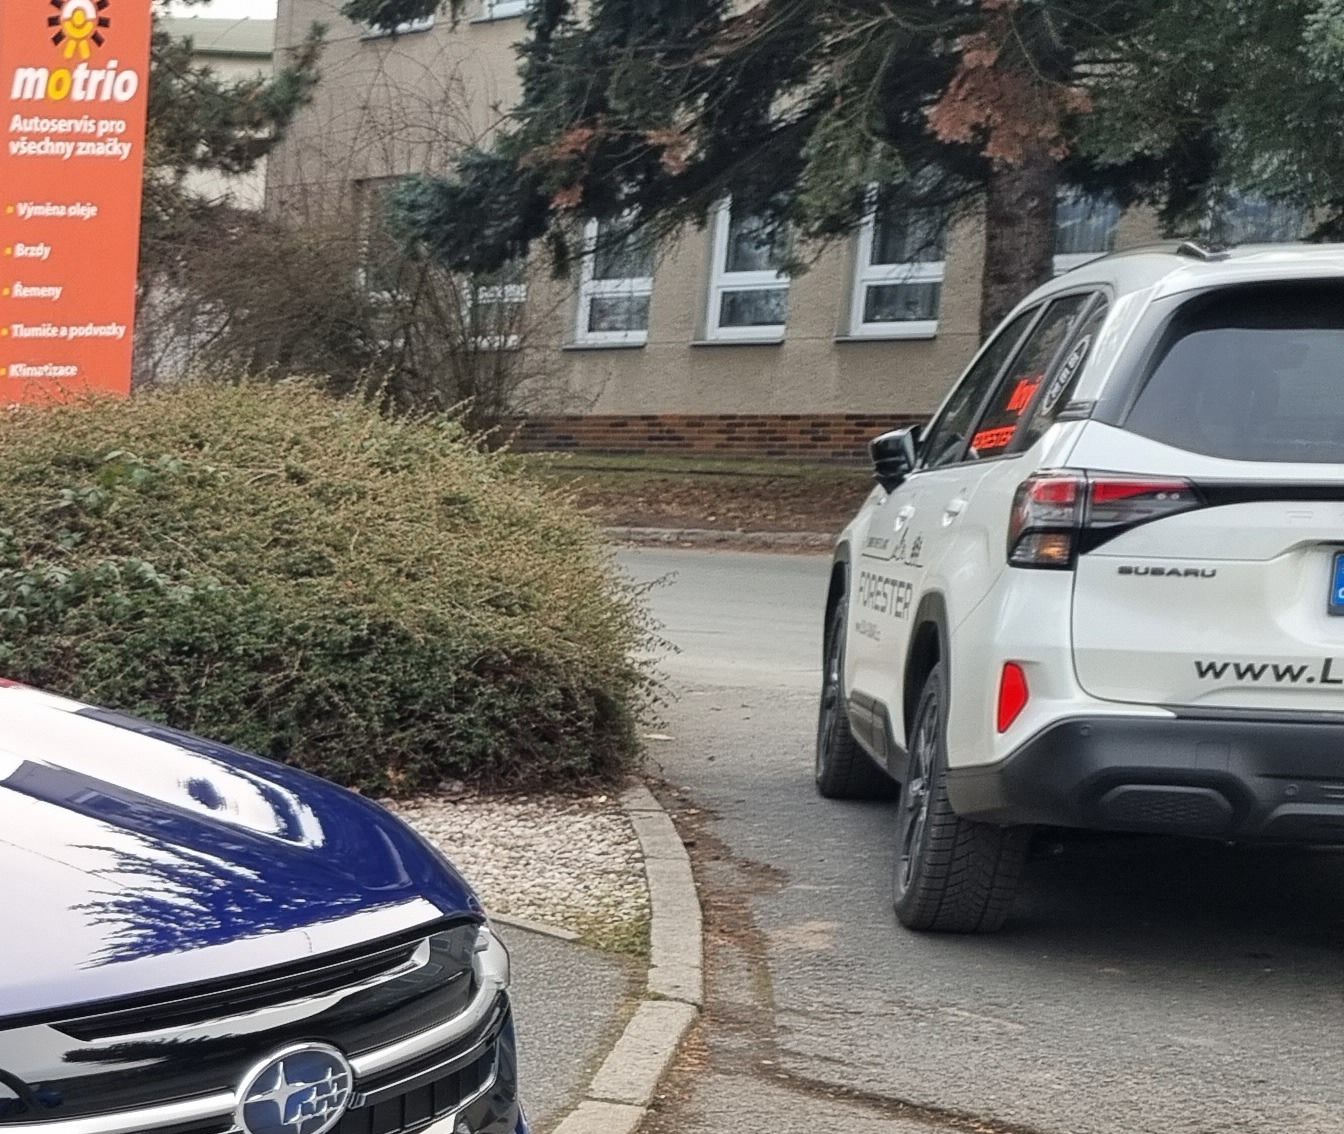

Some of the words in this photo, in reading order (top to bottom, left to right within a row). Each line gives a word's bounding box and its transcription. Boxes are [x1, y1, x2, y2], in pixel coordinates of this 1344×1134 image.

[11, 60, 139, 102] motrio
[9, 114, 96, 133] Autoservis
[96, 119, 126, 137] pro
[9, 137, 75, 160] všechny
[76, 138, 132, 161] značky
[17, 202, 66, 220] Výměna
[68, 202, 98, 220] oleje
[14, 243, 52, 260] Brzdy
[13, 281, 63, 301] Řemeny
[12, 323, 59, 338] Tlumiče
[59, 329, 68, 338] a
[68, 322, 126, 340] podvozky
[9, 363, 79, 378] Klimatizace
[1118, 566, 1217, 578] SUBARU
[858, 571, 913, 621] FORESTER
